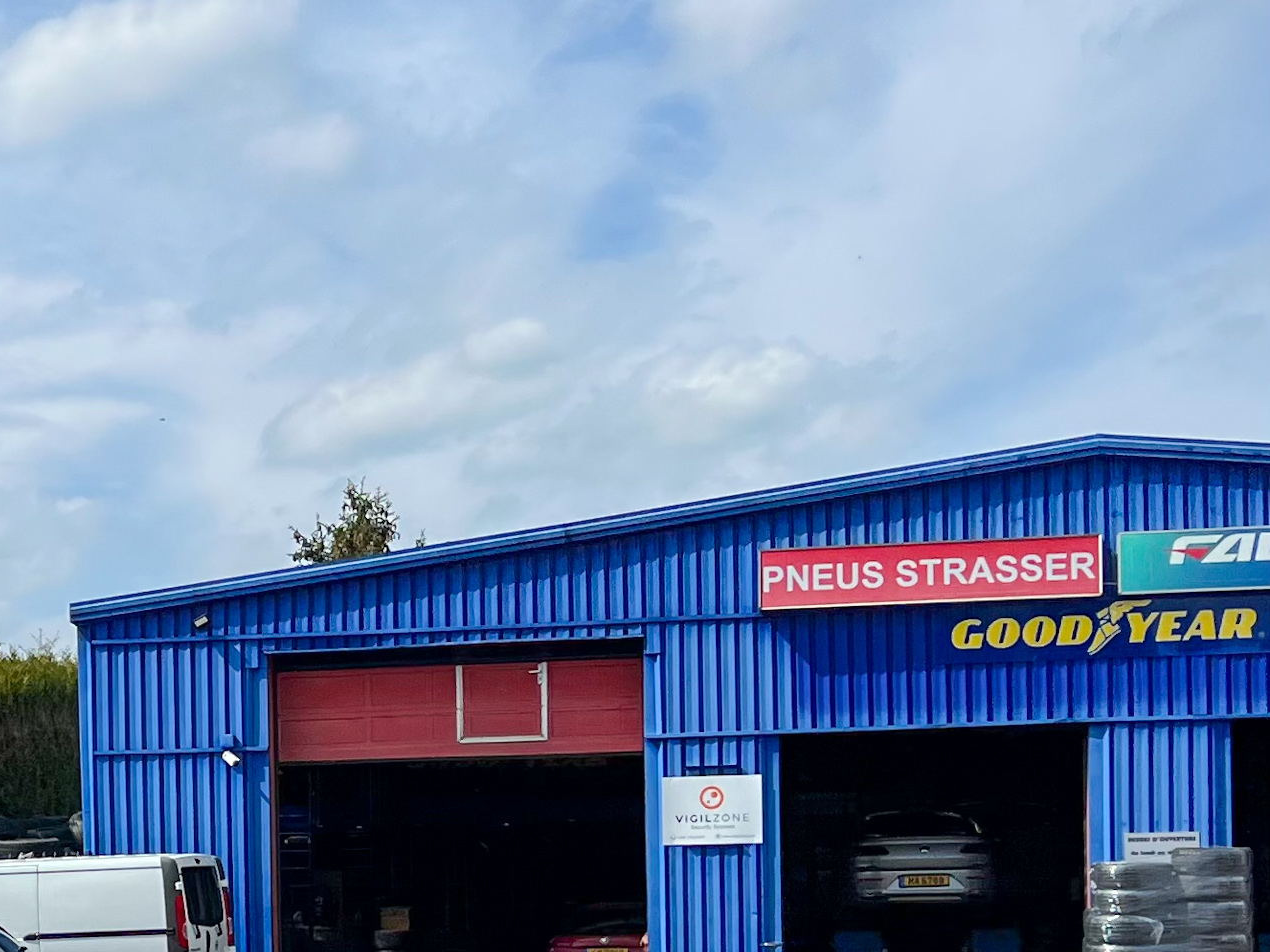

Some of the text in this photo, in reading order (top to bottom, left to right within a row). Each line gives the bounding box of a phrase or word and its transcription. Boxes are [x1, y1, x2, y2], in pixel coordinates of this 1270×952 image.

[762, 551, 1096, 593] PNEUS STRASSER
[675, 812, 750, 823] VIGILZONE
